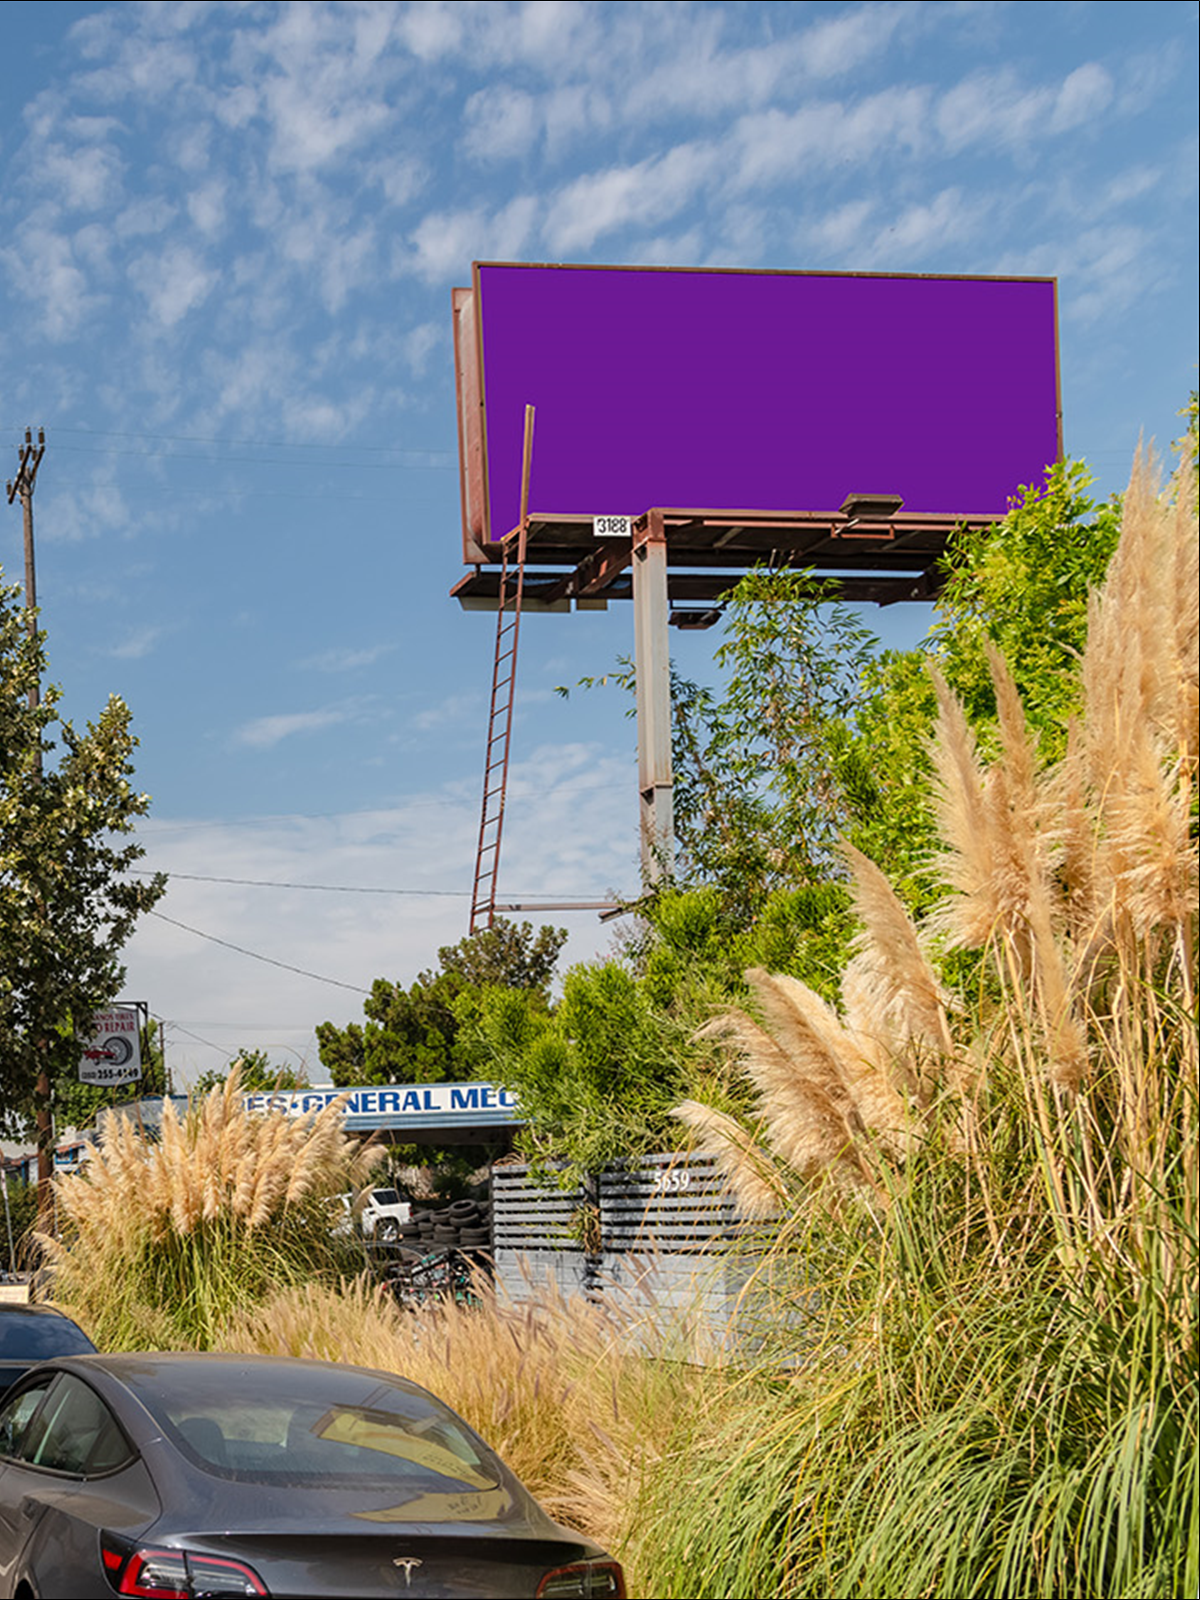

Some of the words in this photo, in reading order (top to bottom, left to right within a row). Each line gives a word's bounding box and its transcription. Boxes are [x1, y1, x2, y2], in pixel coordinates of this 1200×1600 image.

[597, 517, 628, 533] 3188
[105, 1021, 135, 1032] REPAIR
[654, 1170, 689, 1191] 5659
